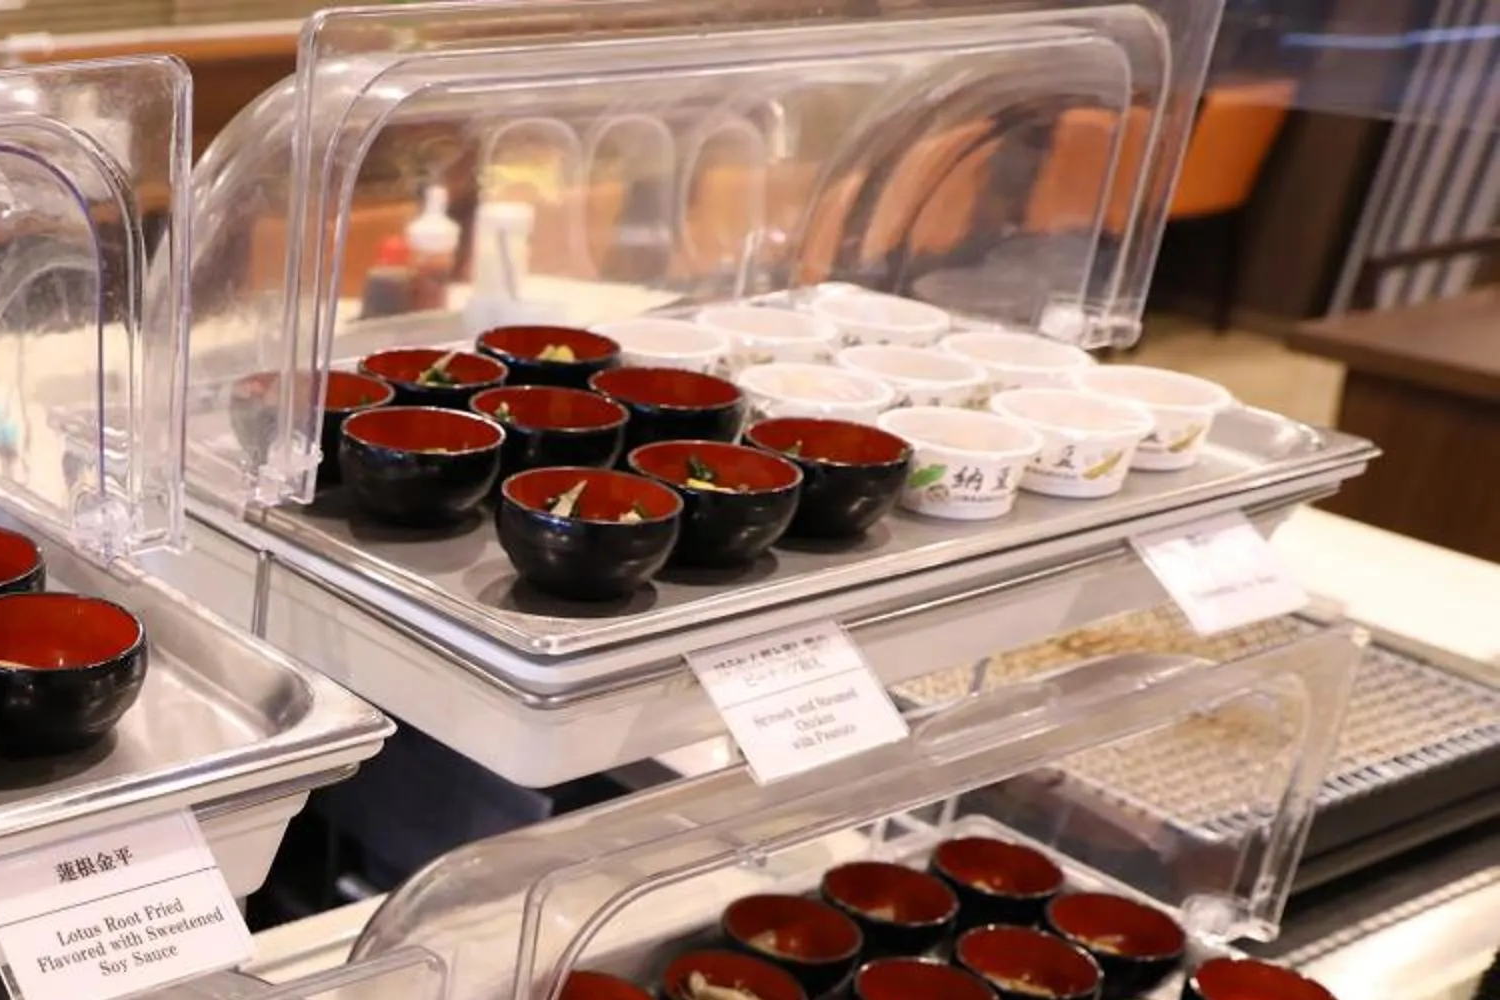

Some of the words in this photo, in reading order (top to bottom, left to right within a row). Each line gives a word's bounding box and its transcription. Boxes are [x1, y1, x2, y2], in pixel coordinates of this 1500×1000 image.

[56, 845, 134, 883] 蓮根金平
[37, 942, 107, 973] Flavored
[110, 932, 143, 953] with
[146, 907, 225, 941] Sweetened
[56, 925, 103, 947] Lotus
[103, 912, 143, 933] Root
[145, 898, 185, 921] Fried
[100, 961, 128, 977] Soy
[132, 946, 178, 967] Sauce
